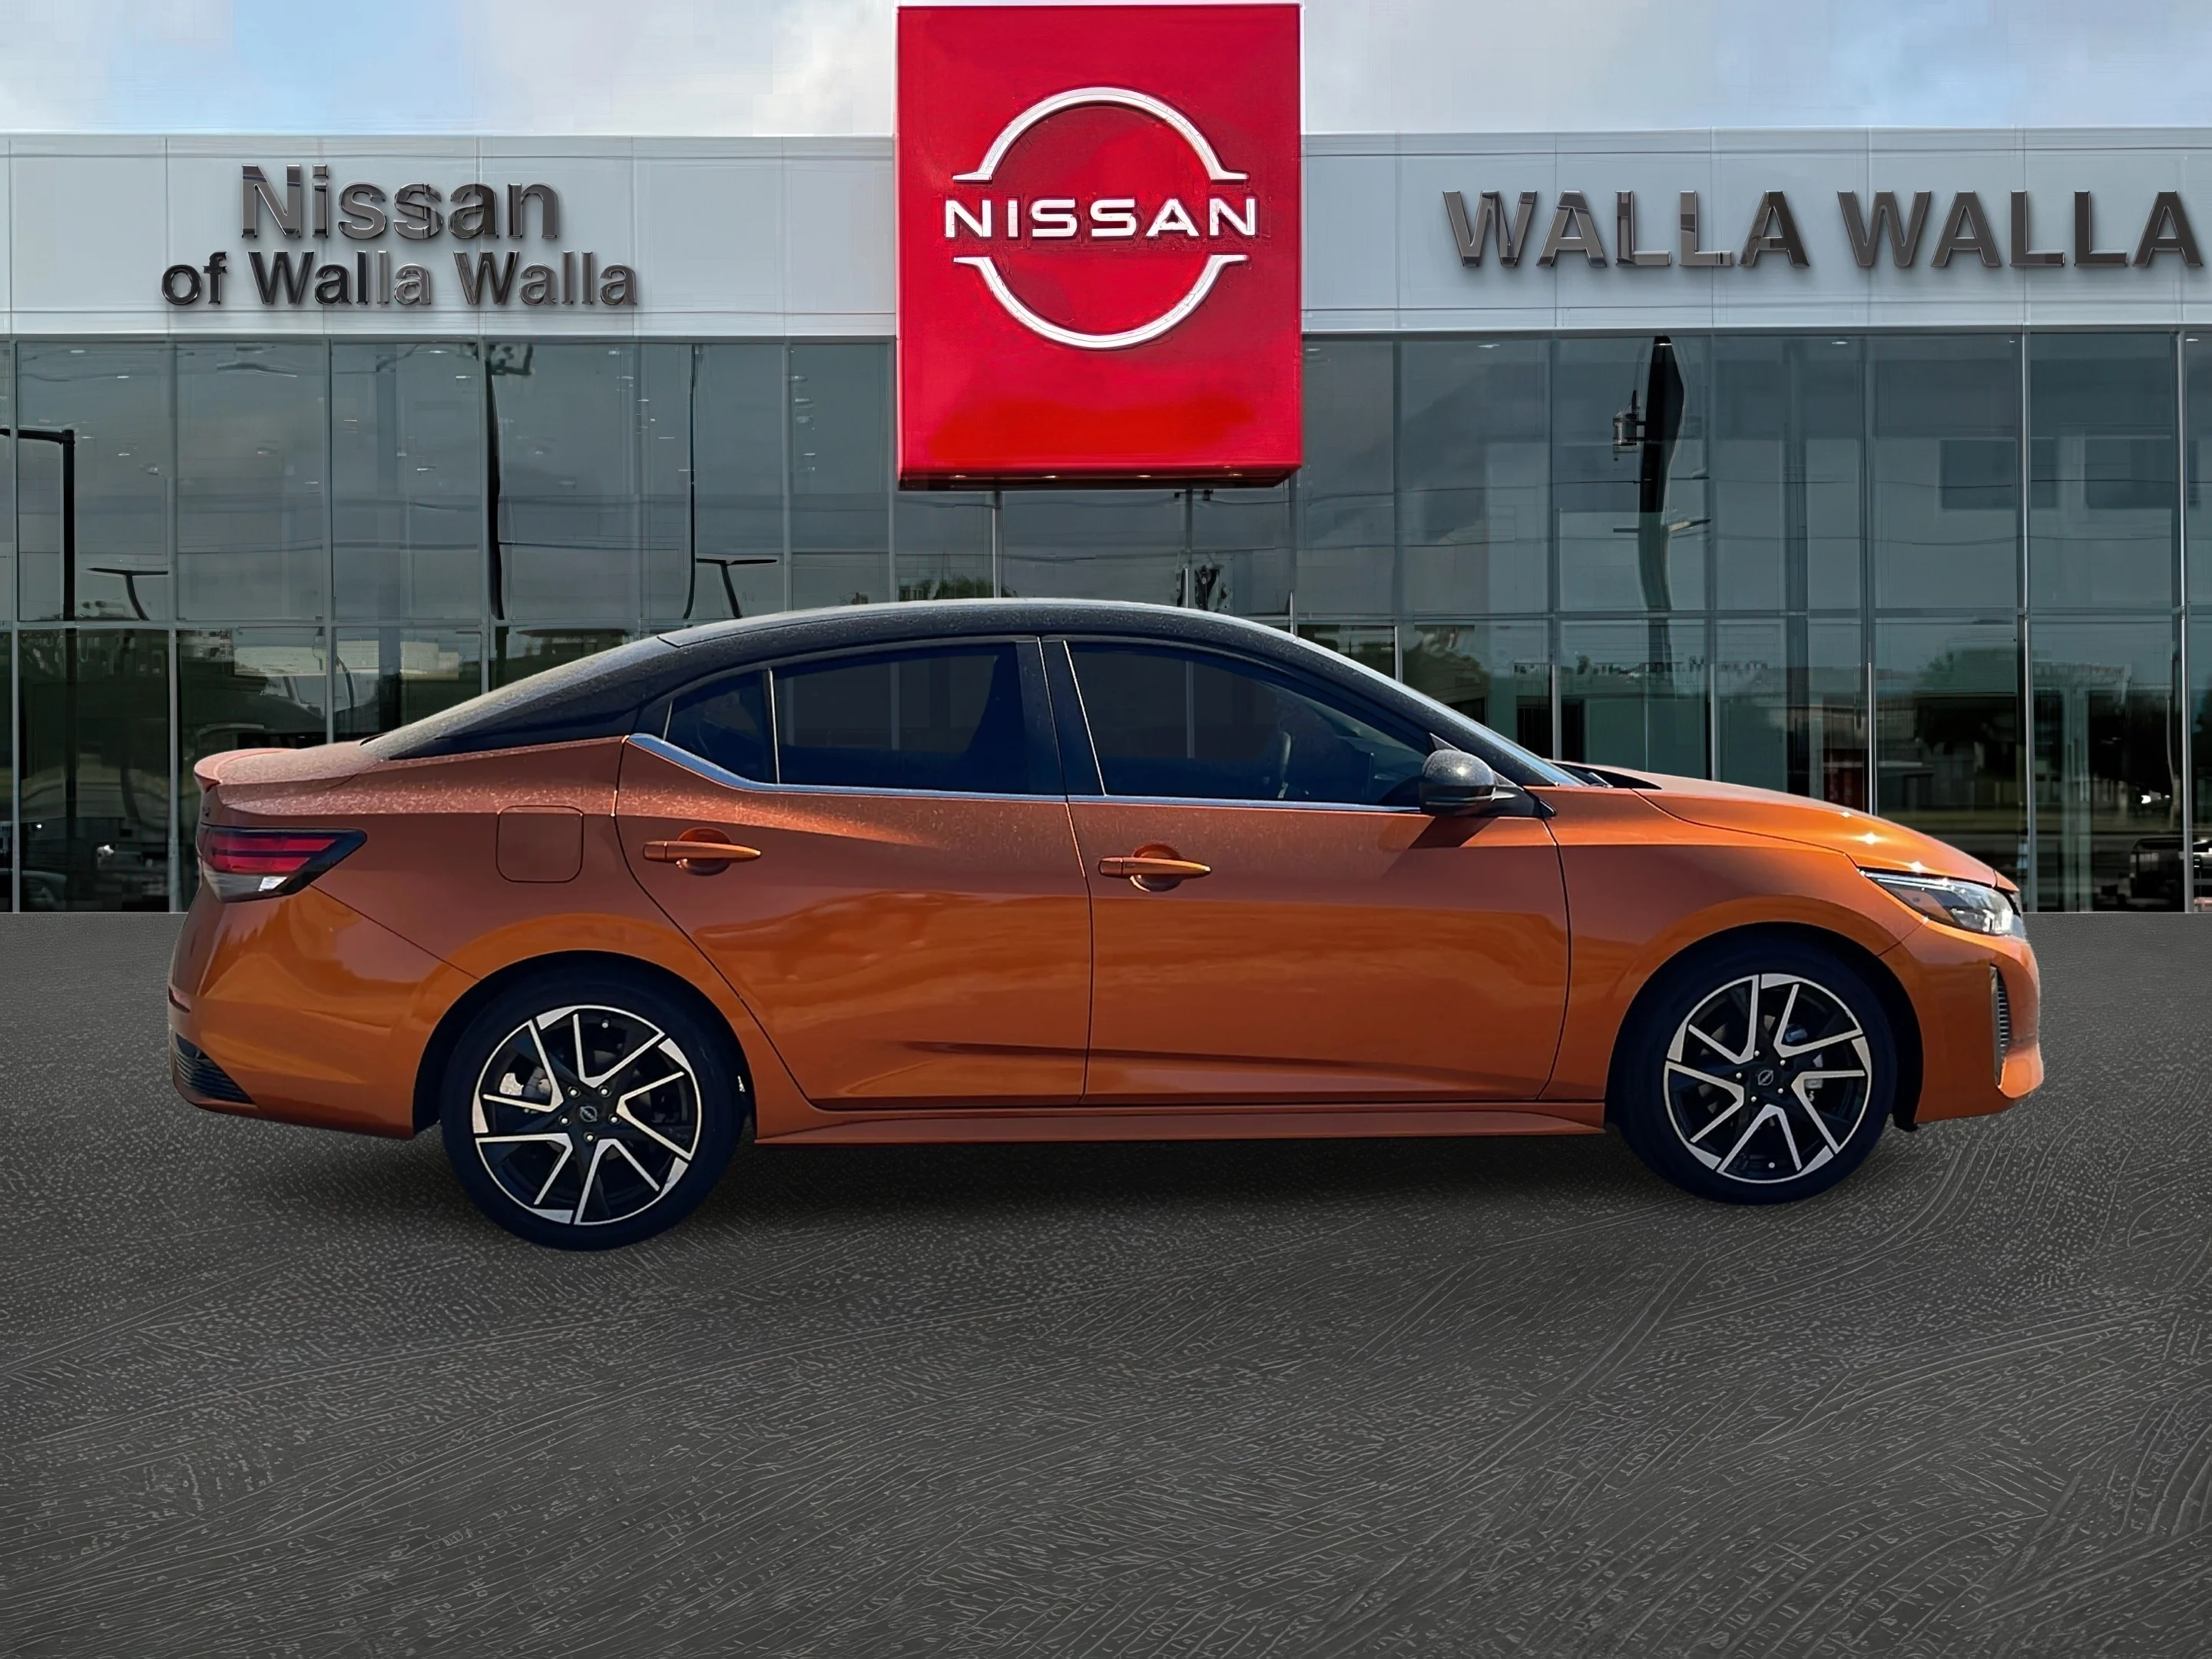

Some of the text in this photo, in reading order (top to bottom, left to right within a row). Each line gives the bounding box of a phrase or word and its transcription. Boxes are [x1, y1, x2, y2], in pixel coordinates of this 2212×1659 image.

[241, 163, 559, 240] Nissan
[945, 198, 1257, 237] NISSAN
[1442, 190, 2204, 268] WALLA WALLA
[161, 250, 637, 306] of Walla Walla
